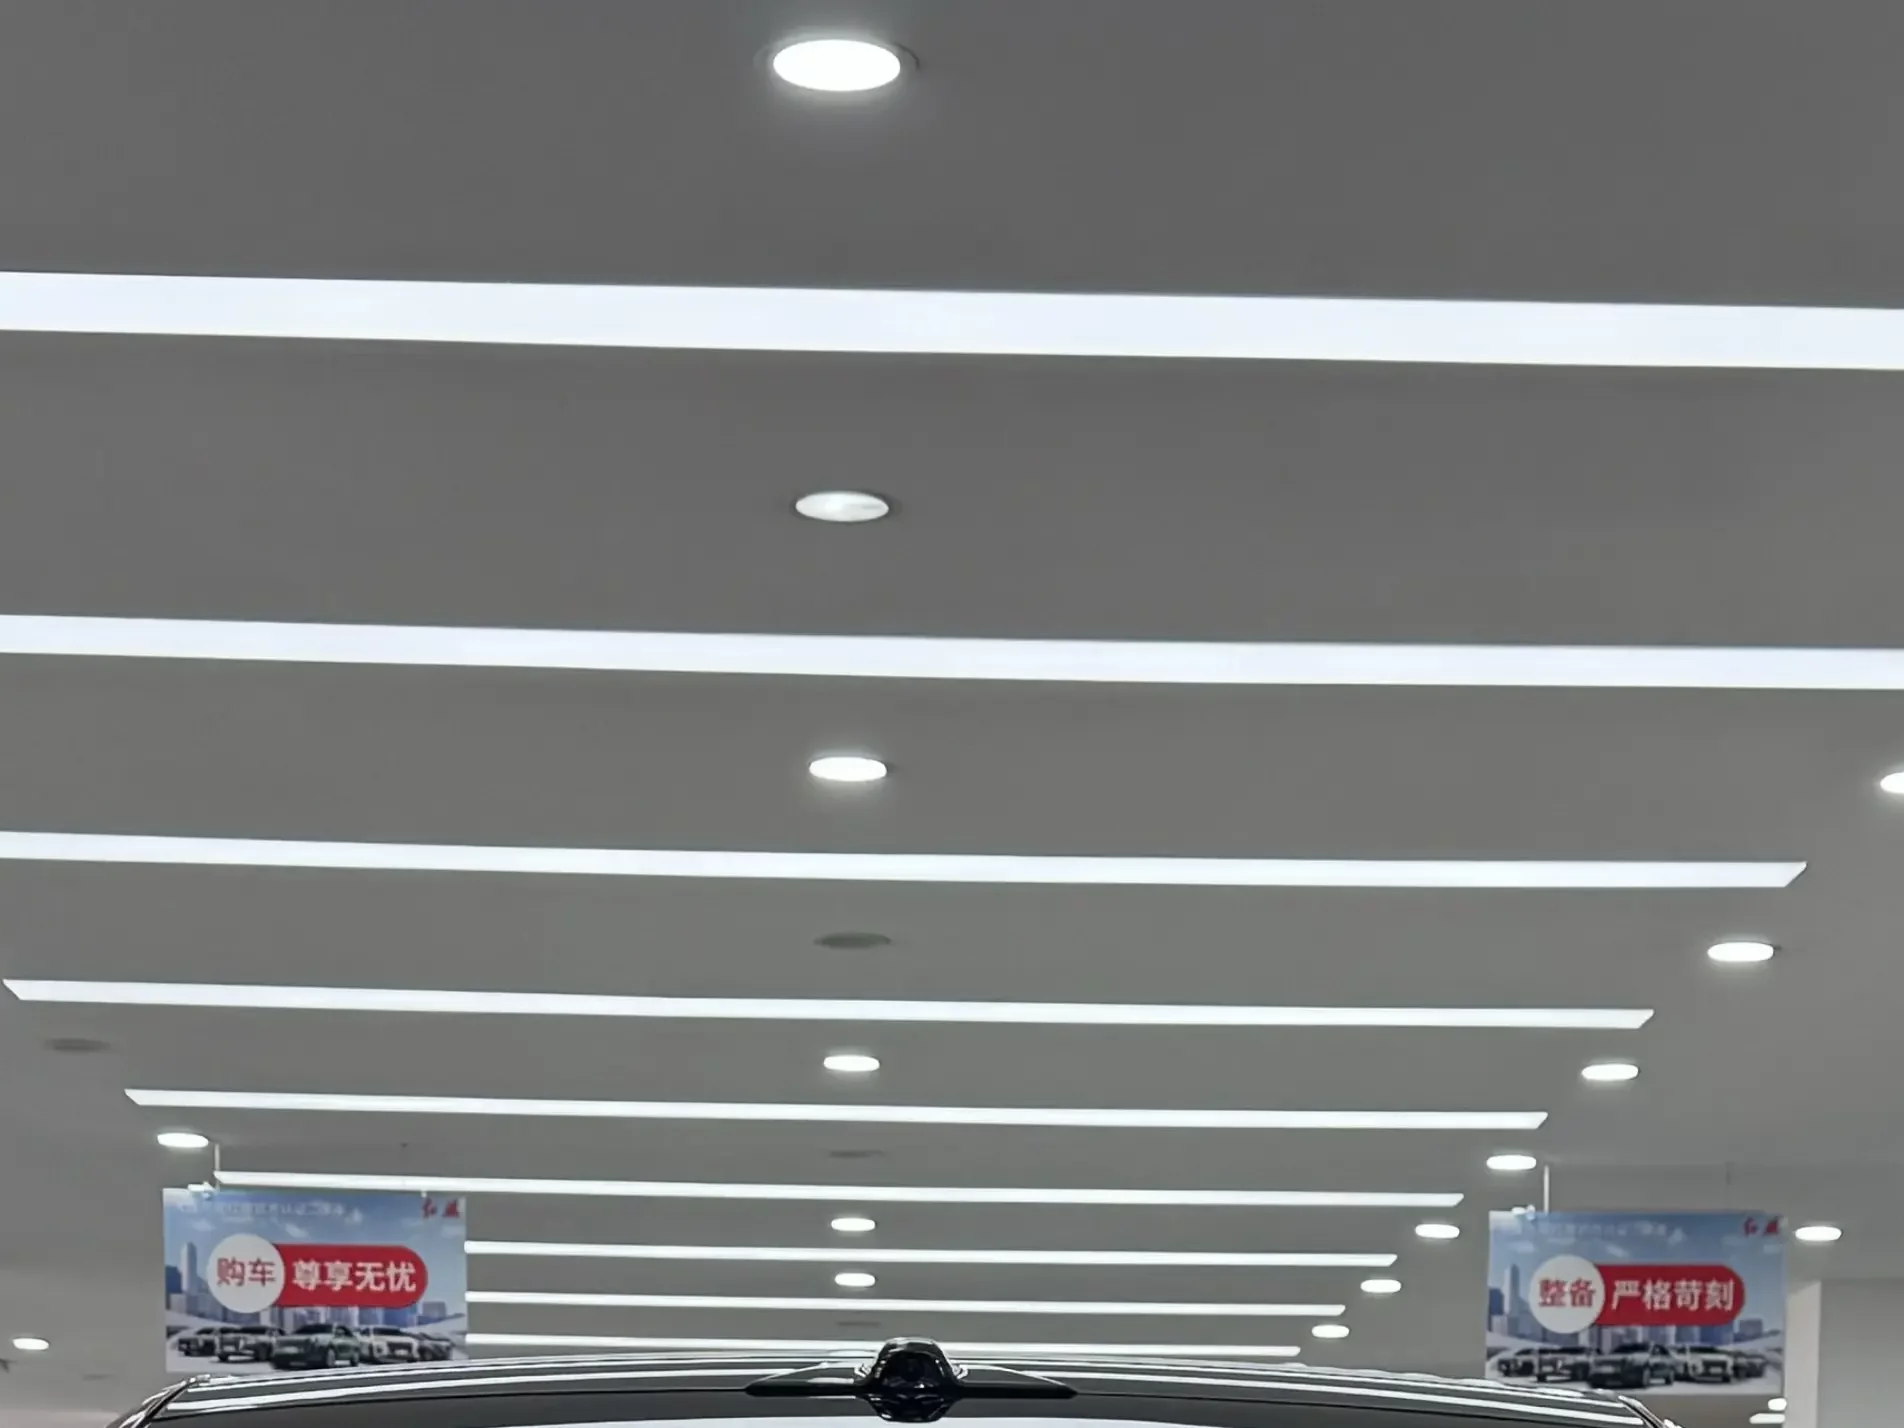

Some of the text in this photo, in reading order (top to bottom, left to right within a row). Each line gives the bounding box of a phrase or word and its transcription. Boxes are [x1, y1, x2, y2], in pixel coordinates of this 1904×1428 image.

[216, 1256, 416, 1293] 购车 尊享无忧
